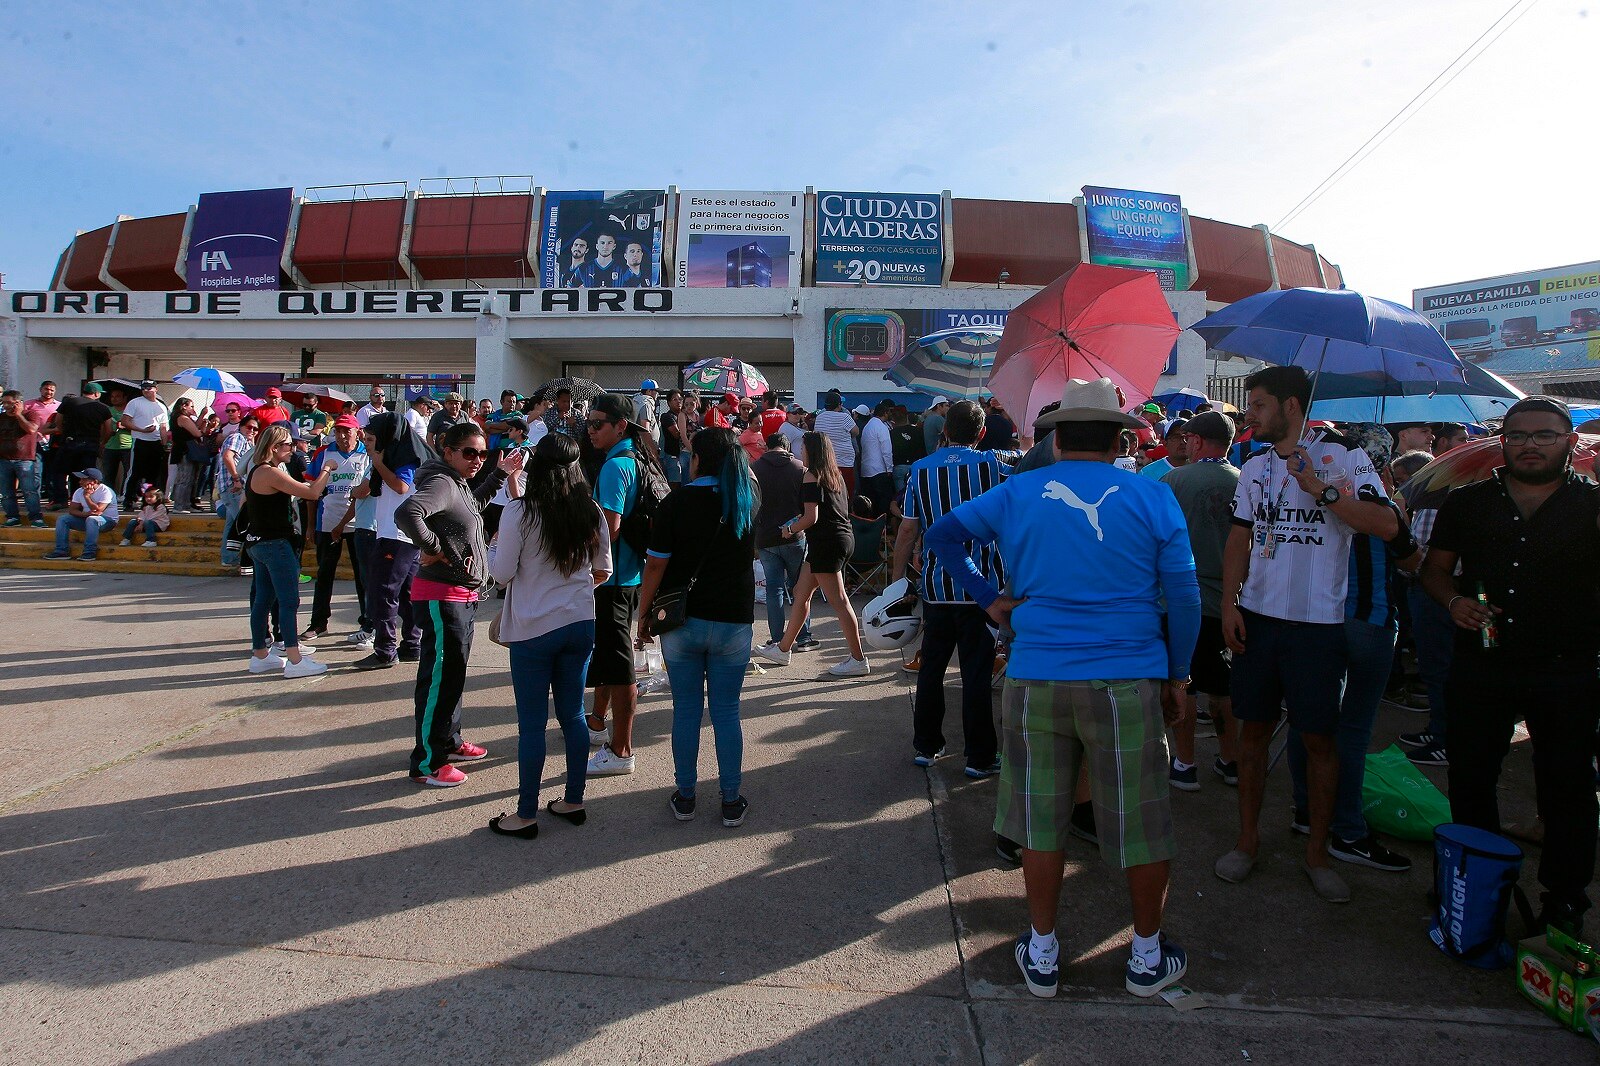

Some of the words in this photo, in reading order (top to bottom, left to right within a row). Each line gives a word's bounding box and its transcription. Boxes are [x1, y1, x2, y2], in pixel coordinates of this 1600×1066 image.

[691, 197, 712, 206] Este
[729, 198, 738, 207] el
[740, 199, 776, 207] estadio
[820, 194, 937, 220] CIUDAD
[1092, 194, 1135, 209] JUNTOS
[1137, 199, 1179, 214] SOMOS
[690, 211, 712, 219] para
[714, 210, 742, 219] hacer
[744, 211, 790, 221] negocios
[1111, 209, 1129, 221] UN
[1131, 211, 1163, 225] GRAN
[689, 222, 702, 230] de
[704, 222, 742, 231] primera
[744, 223, 785, 232] división.
[820, 217, 938, 241] MADERAS
[821, 244, 865, 253] TERRENOS
[866, 245, 886, 253] CON
[886, 246, 915, 254] CASAS
[916, 247, 939, 255] CLUB
[848, 259, 881, 281] 20
[882, 263, 926, 273] NUEVAS
[881, 274, 926, 282] amenidades
[200, 275, 241, 288] Hospitales
[243, 273, 276, 287] Angeles
[1429, 294, 1474, 308] NUEVA
[1476, 284, 1532, 301] FAMILIA
[1545, 274, 1600, 291] DELIVE
[11, 291, 129, 314] ORA
[165, 291, 241, 314] DE
[278, 289, 673, 316] QUERETARO
[1487, 304, 1499, 312] LA
[1500, 299, 1537, 310] MEDIDA
[1539, 296, 1552, 304] DE
[1554, 295, 1568, 303] TU
[1570, 290, 1600, 301] NEGO
[947, 313, 1009, 328] TAQUI
